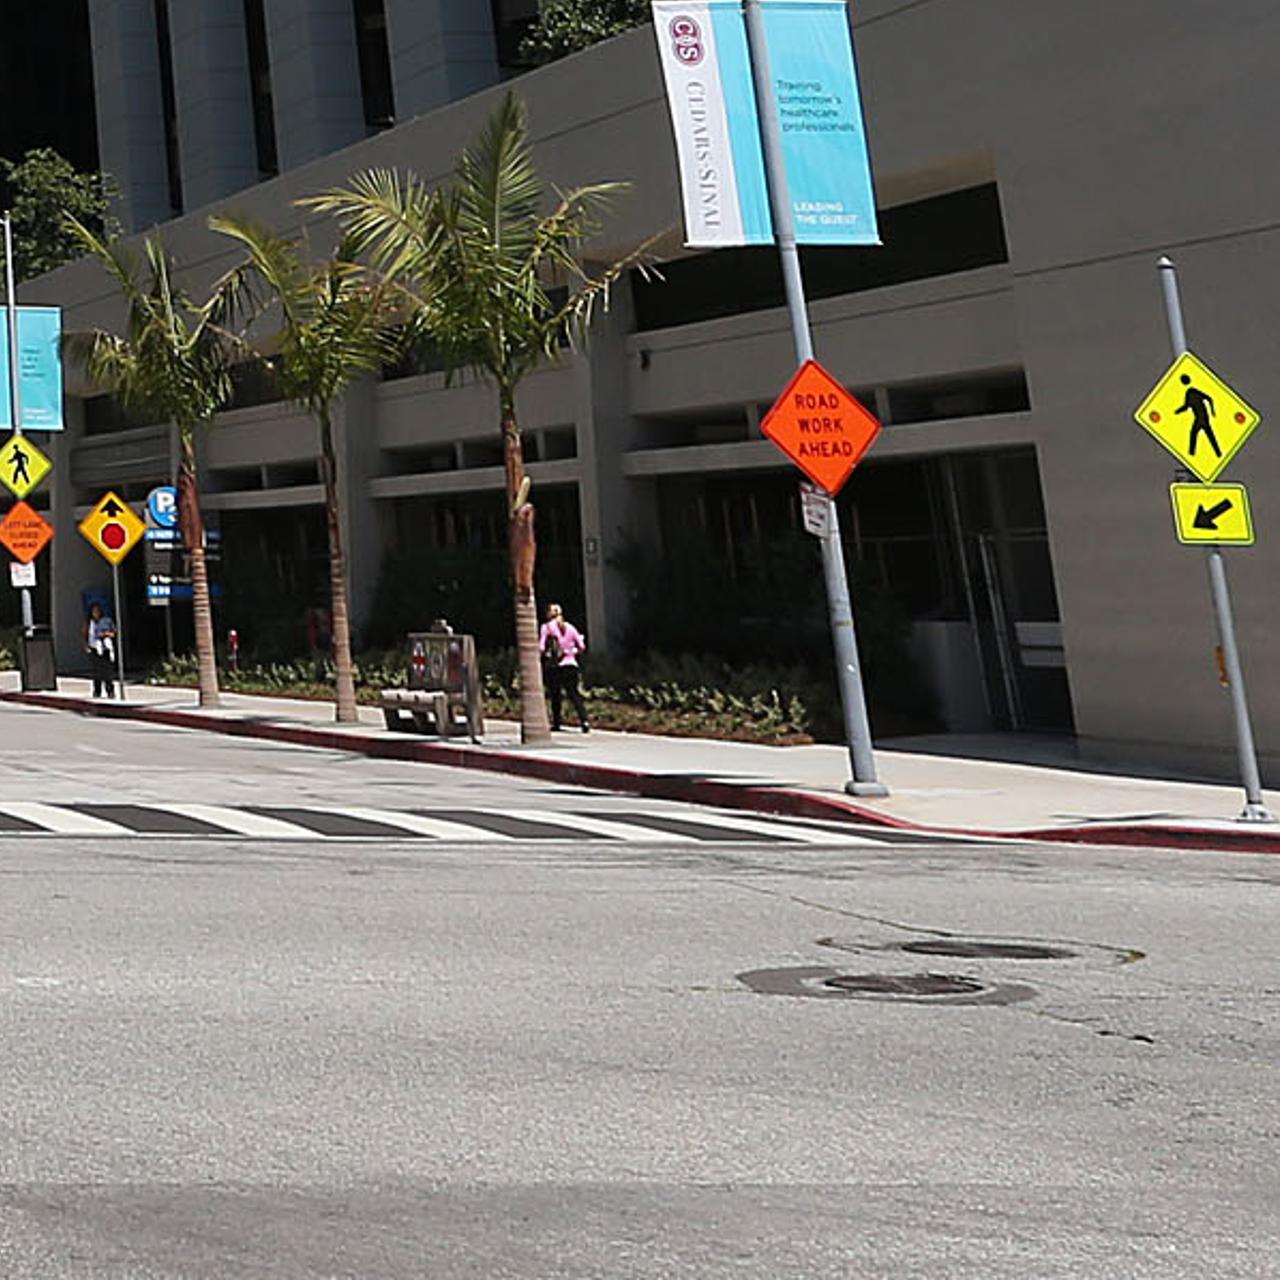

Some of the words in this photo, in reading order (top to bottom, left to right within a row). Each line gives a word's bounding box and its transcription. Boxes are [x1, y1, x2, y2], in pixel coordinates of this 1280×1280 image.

[777, 80, 822, 92] Training
[778, 95, 842, 105] tomorrow's
[780, 108, 839, 119] healthcare
[782, 122, 855, 134] professionals
[793, 202, 844, 213] LEADING
[797, 214, 817, 225] THE
[821, 214, 858, 226] QUEST
[794, 393, 839, 409] ROAD
[798, 418, 843, 433] WORK
[799, 441, 852, 457] AHEAD
